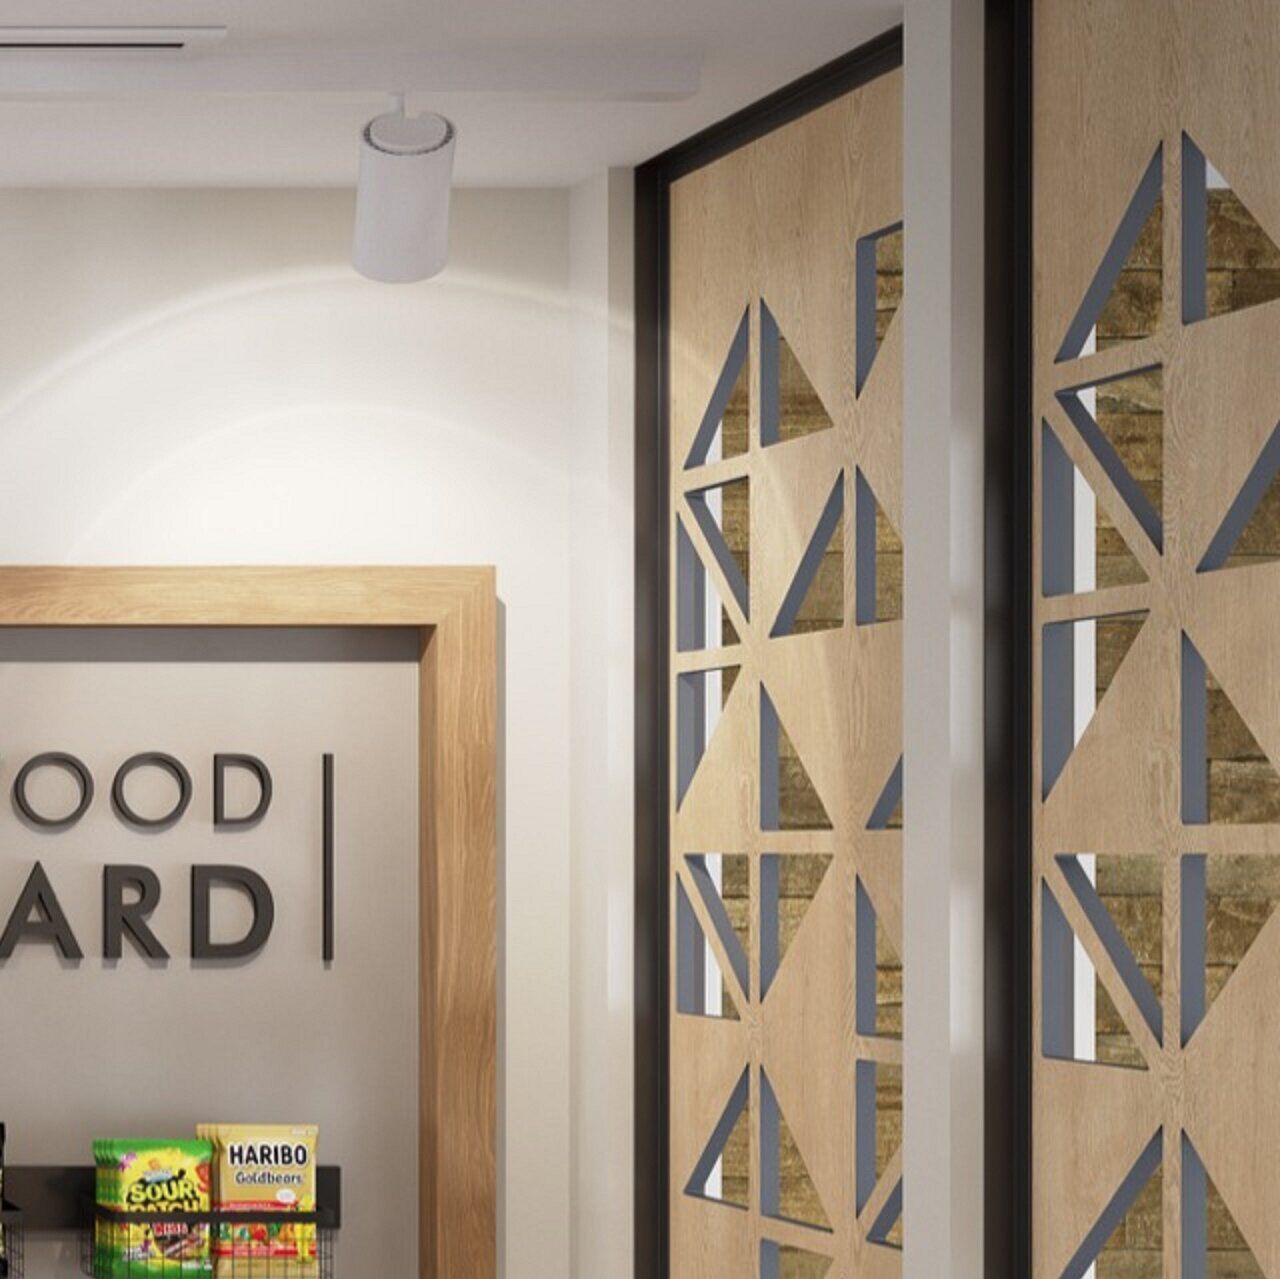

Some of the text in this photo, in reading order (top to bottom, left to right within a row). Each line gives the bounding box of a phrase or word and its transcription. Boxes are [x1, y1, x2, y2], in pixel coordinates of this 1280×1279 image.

[229, 1145, 307, 1166] HARIBO
[236, 1172, 303, 1187] Goldbears
[130, 1180, 197, 1203] SOUR
